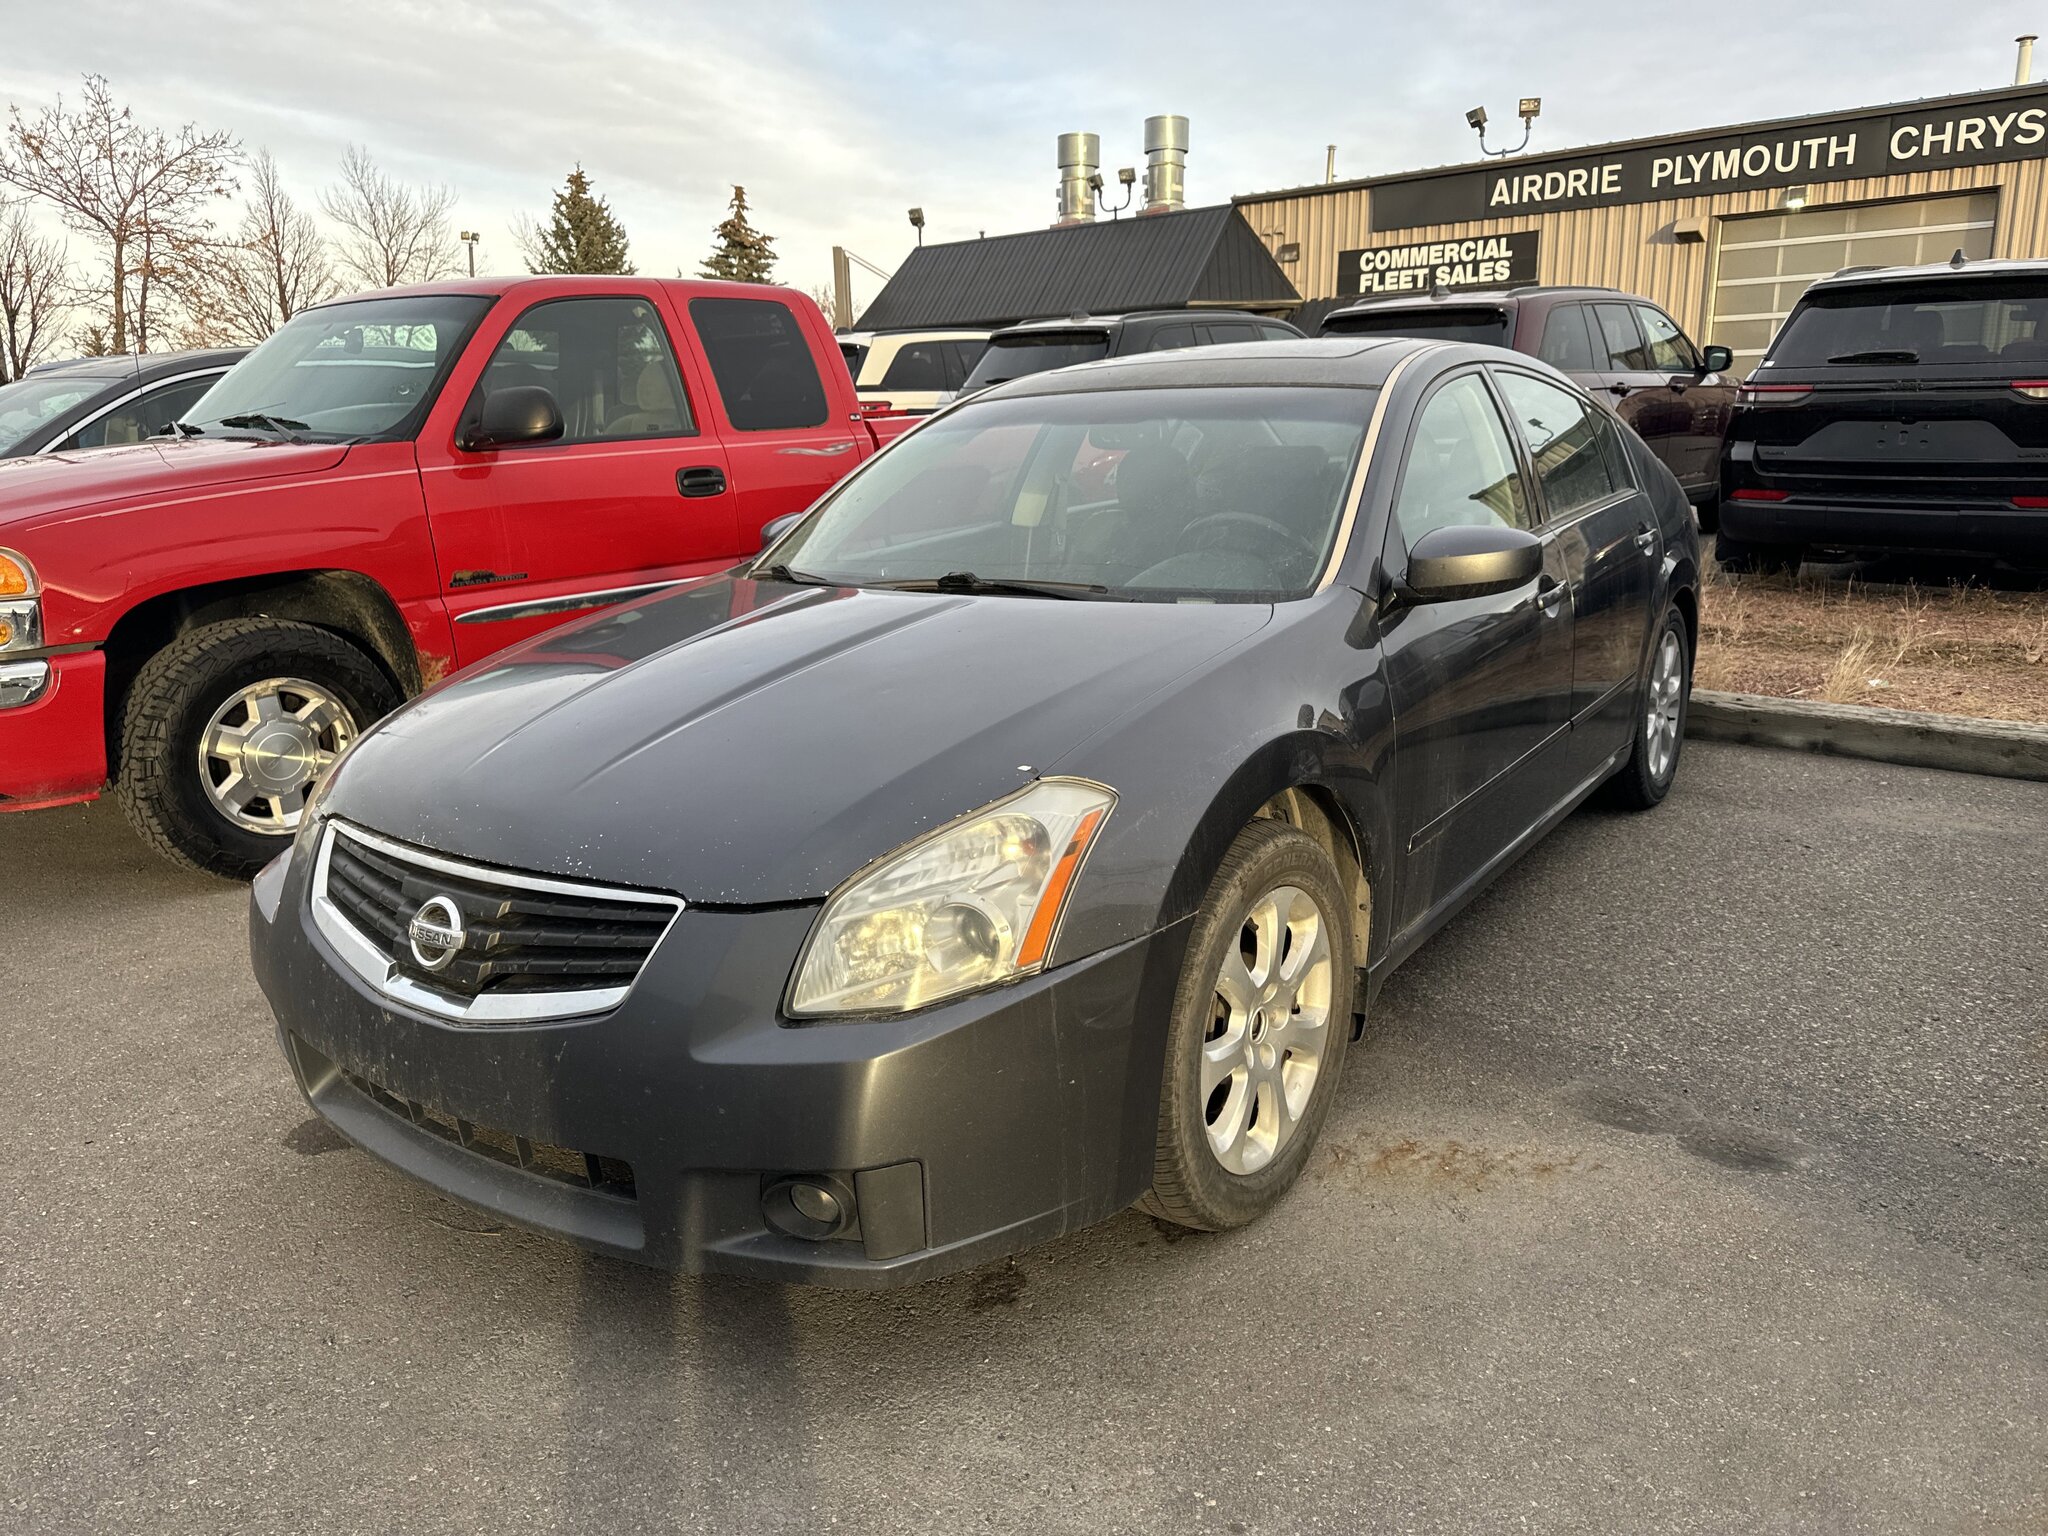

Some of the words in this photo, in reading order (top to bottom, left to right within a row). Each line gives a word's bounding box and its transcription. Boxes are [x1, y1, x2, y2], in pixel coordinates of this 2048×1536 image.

[1490, 164, 1622, 206] AIRDRIE
[1651, 134, 1856, 188] PLYMOUTH
[1890, 108, 2047, 160] CHRYS
[1359, 237, 1513, 272] COMMERCIAL
[1359, 267, 1429, 293] FLEET
[1435, 260, 1511, 286] SALES
[452, 578, 488, 588] NEVADA
[489, 573, 526, 583] EDITION
[410, 924, 453, 946] NISSAN
